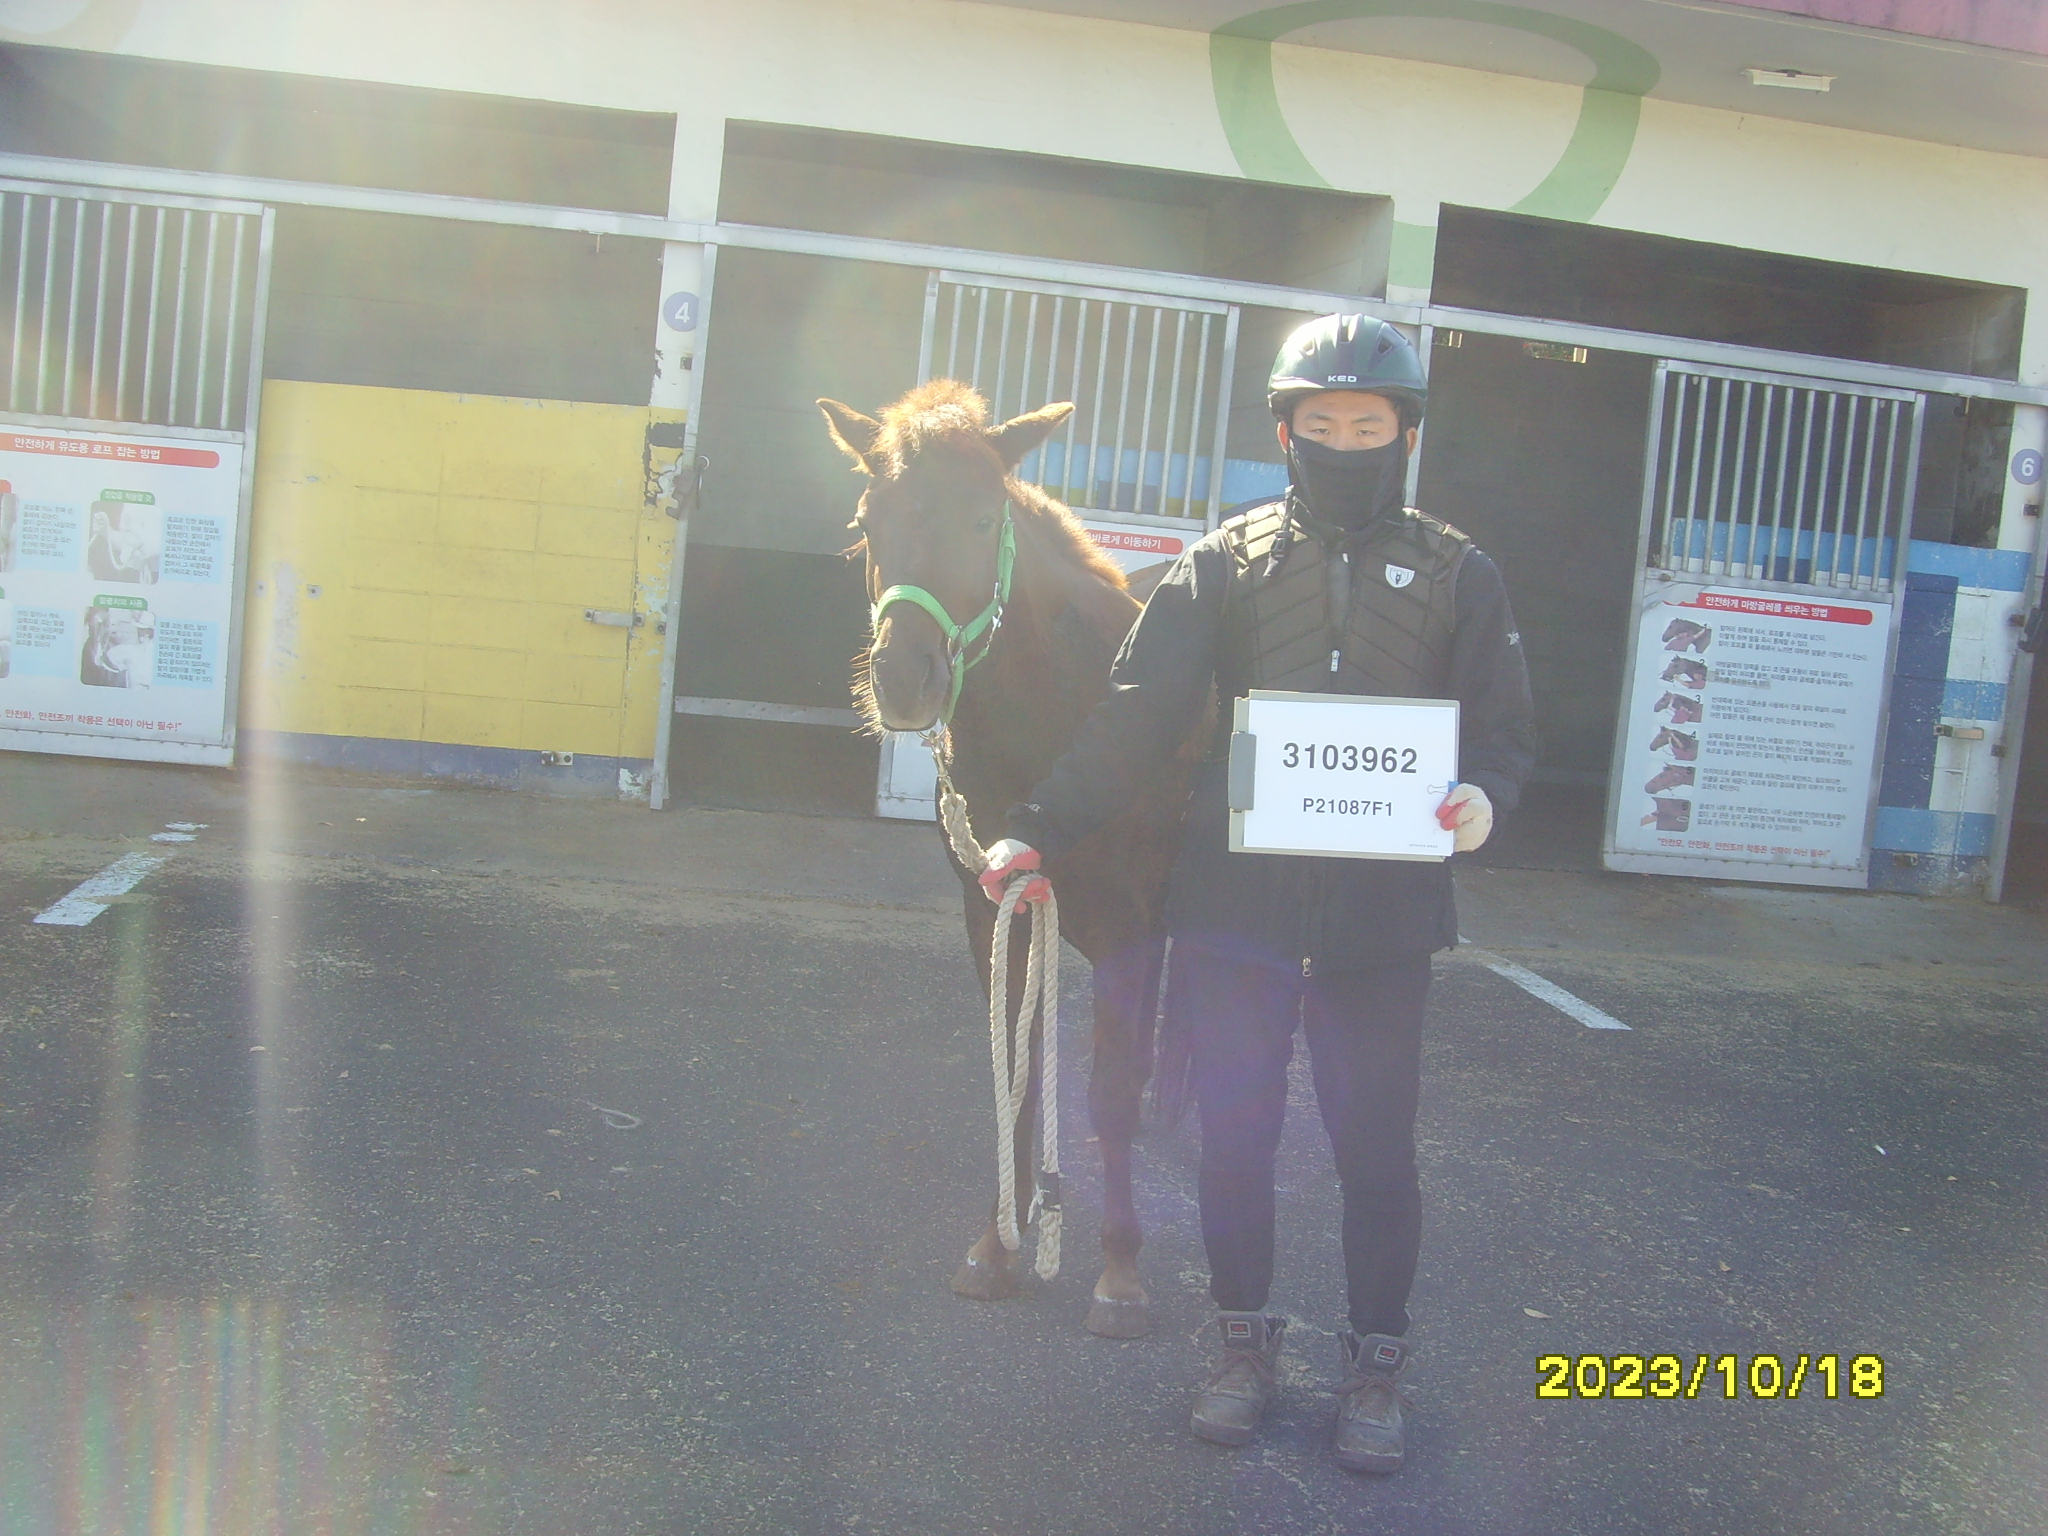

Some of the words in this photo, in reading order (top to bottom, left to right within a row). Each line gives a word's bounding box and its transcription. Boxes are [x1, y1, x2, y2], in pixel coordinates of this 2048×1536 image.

[674, 301, 690, 324] 4
[1327, 375, 1358, 383] KED
[14, 437, 55, 451] 안전하게
[58, 441, 89, 454] 유도용
[92, 444, 113, 455] 로프
[116, 446, 137, 458] 잡는
[140, 448, 161, 460] 방법
[2021, 457, 2035, 477] 6
[1123, 534, 1162, 550] 이동하기
[1705, 596, 1739, 609] 안전하게
[1741, 599, 1782, 613] 마방굴레를
[1811, 607, 1828, 618] 방법
[1695, 695, 1701, 704] 3
[38, 711, 74, 723] 안전조끼
[77, 714, 103, 725] 착용은
[107, 717, 133, 728] 선택이
[136, 720, 154, 730] 아닌
[1690, 730, 1697, 740] 4
[1282, 742, 1418, 774] 3103962
[1686, 766, 1692, 776] 5
[1303, 797, 1393, 817] P21087F1
[1682, 802, 1688, 811] 6
